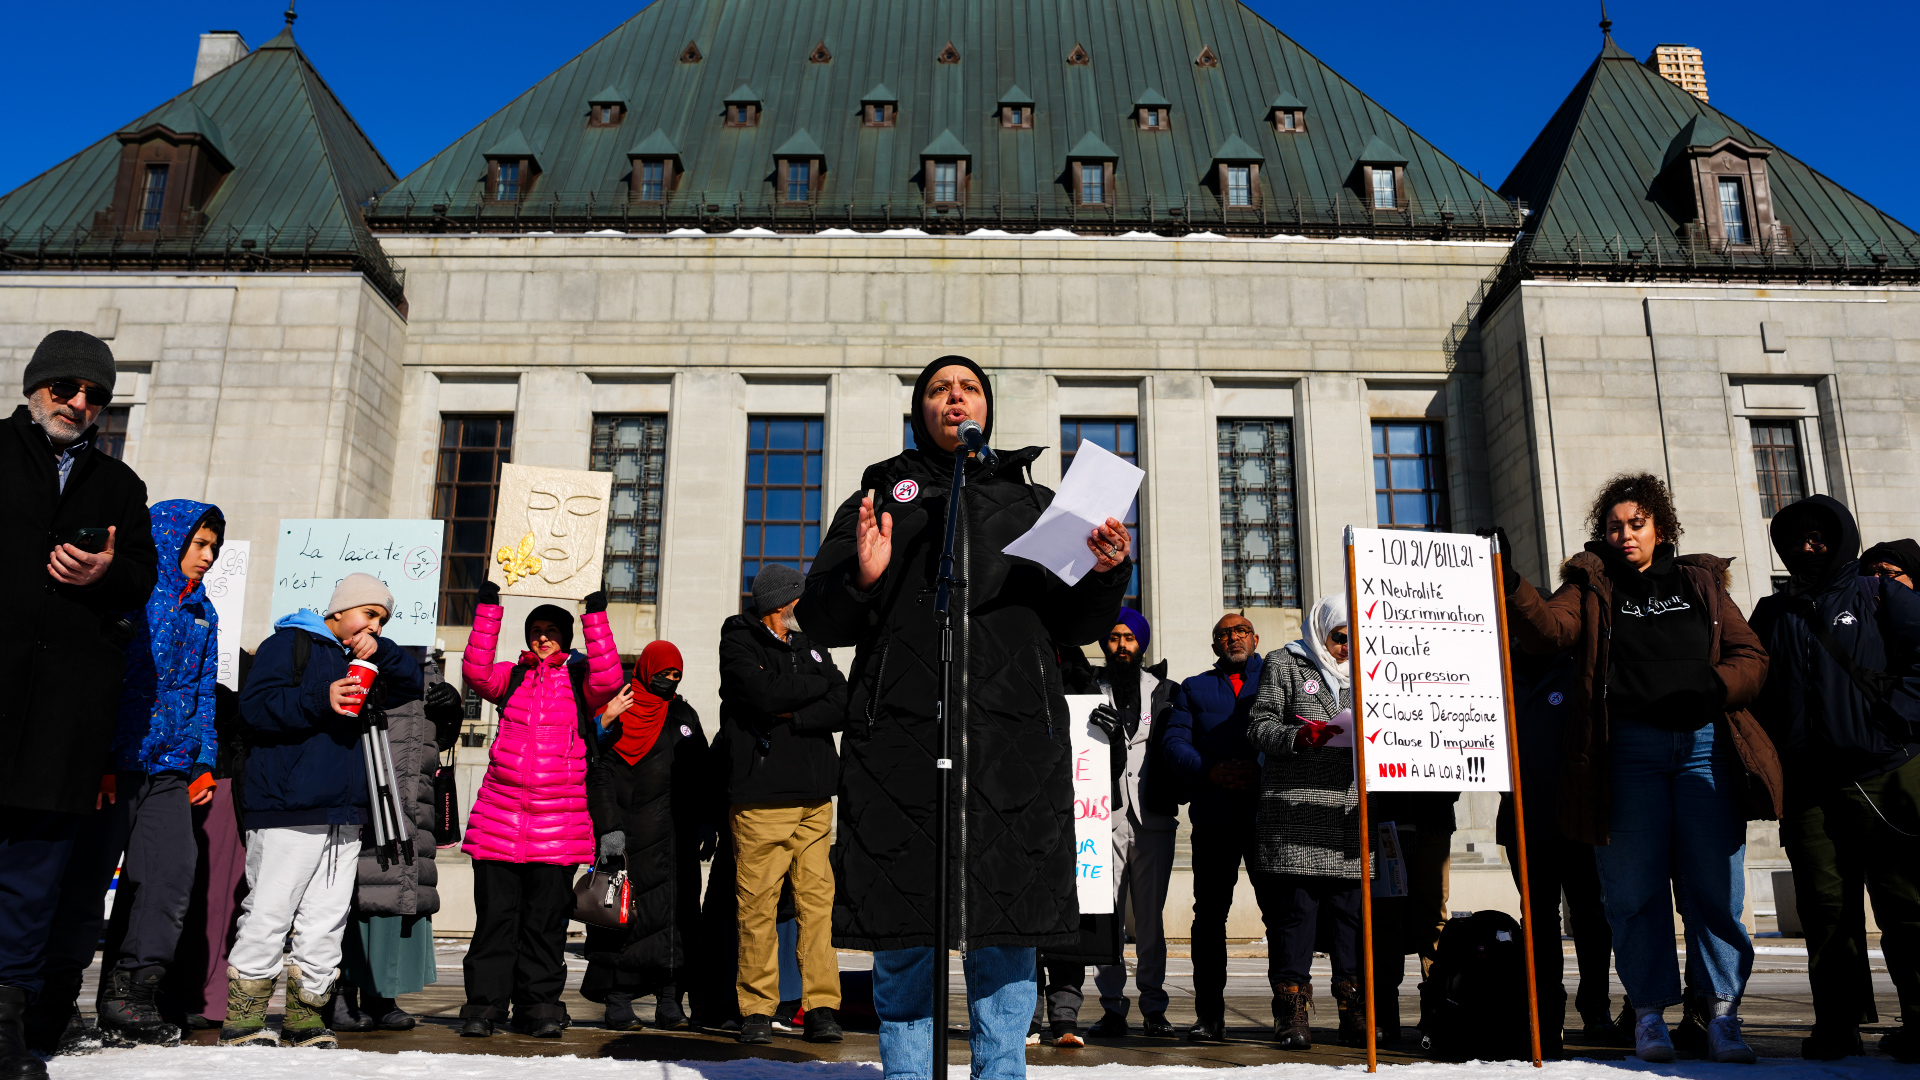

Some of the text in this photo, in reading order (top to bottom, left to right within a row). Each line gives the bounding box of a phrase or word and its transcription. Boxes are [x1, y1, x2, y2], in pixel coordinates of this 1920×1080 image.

[299, 527, 404, 561] La laïcité
[220, 548, 248, 576] ÇA
[279, 571, 323, 589] n'est
[1380, 578, 1444, 600] Neutralité
[390, 604, 403, 620] la
[1382, 600, 1485, 622] Discrimination
[1381, 634, 1431, 656] Laïcité
[1384, 661, 1470, 693] Oppression
[1382, 702, 1424, 721] Clause
[1430, 701, 1497, 733] Dérogatoire
[1383, 731, 1423, 747] Clause
[1378, 762, 1407, 778] NON
[1411, 758, 1420, 778] À
[1423, 763, 1436, 778] LA
